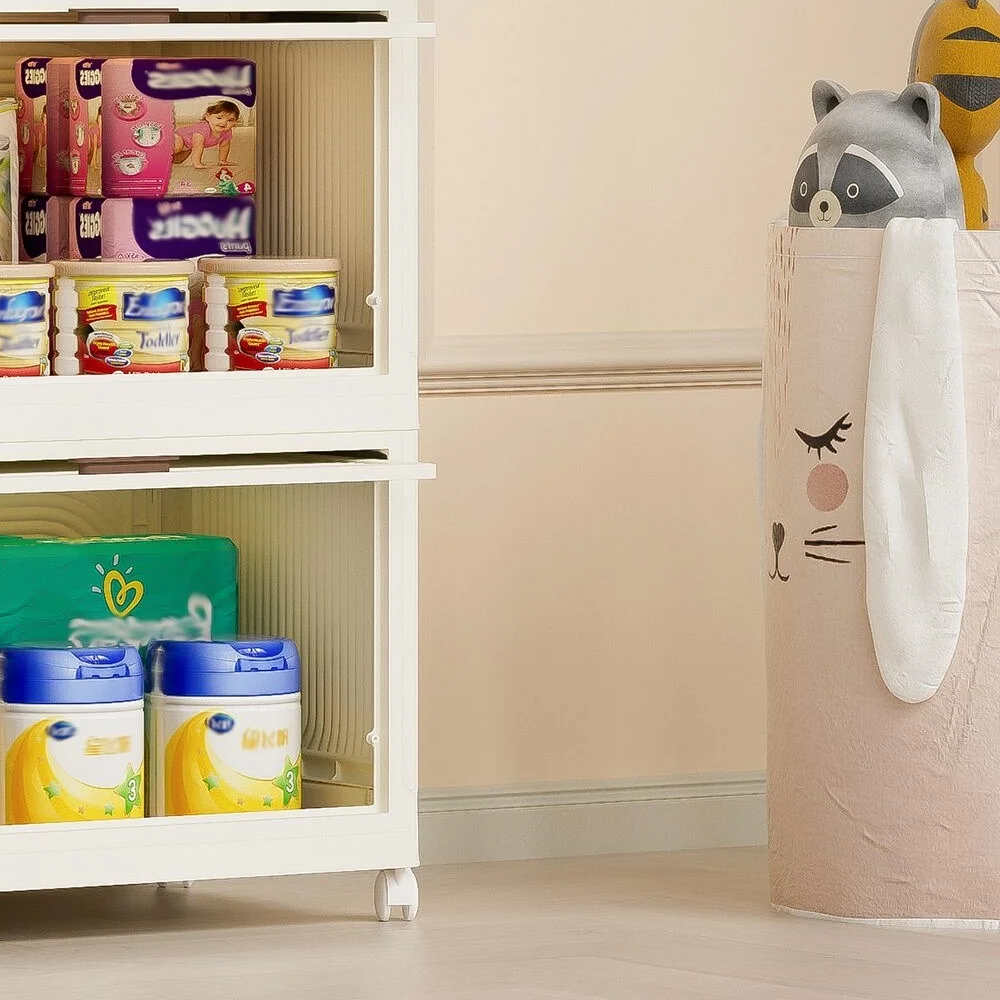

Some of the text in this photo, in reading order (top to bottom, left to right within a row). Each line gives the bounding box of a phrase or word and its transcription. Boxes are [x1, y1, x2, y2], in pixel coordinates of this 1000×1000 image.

[136, 329, 180, 349] Toddler
[127, 779, 136, 802] 3
[286, 771, 294, 793] 3
